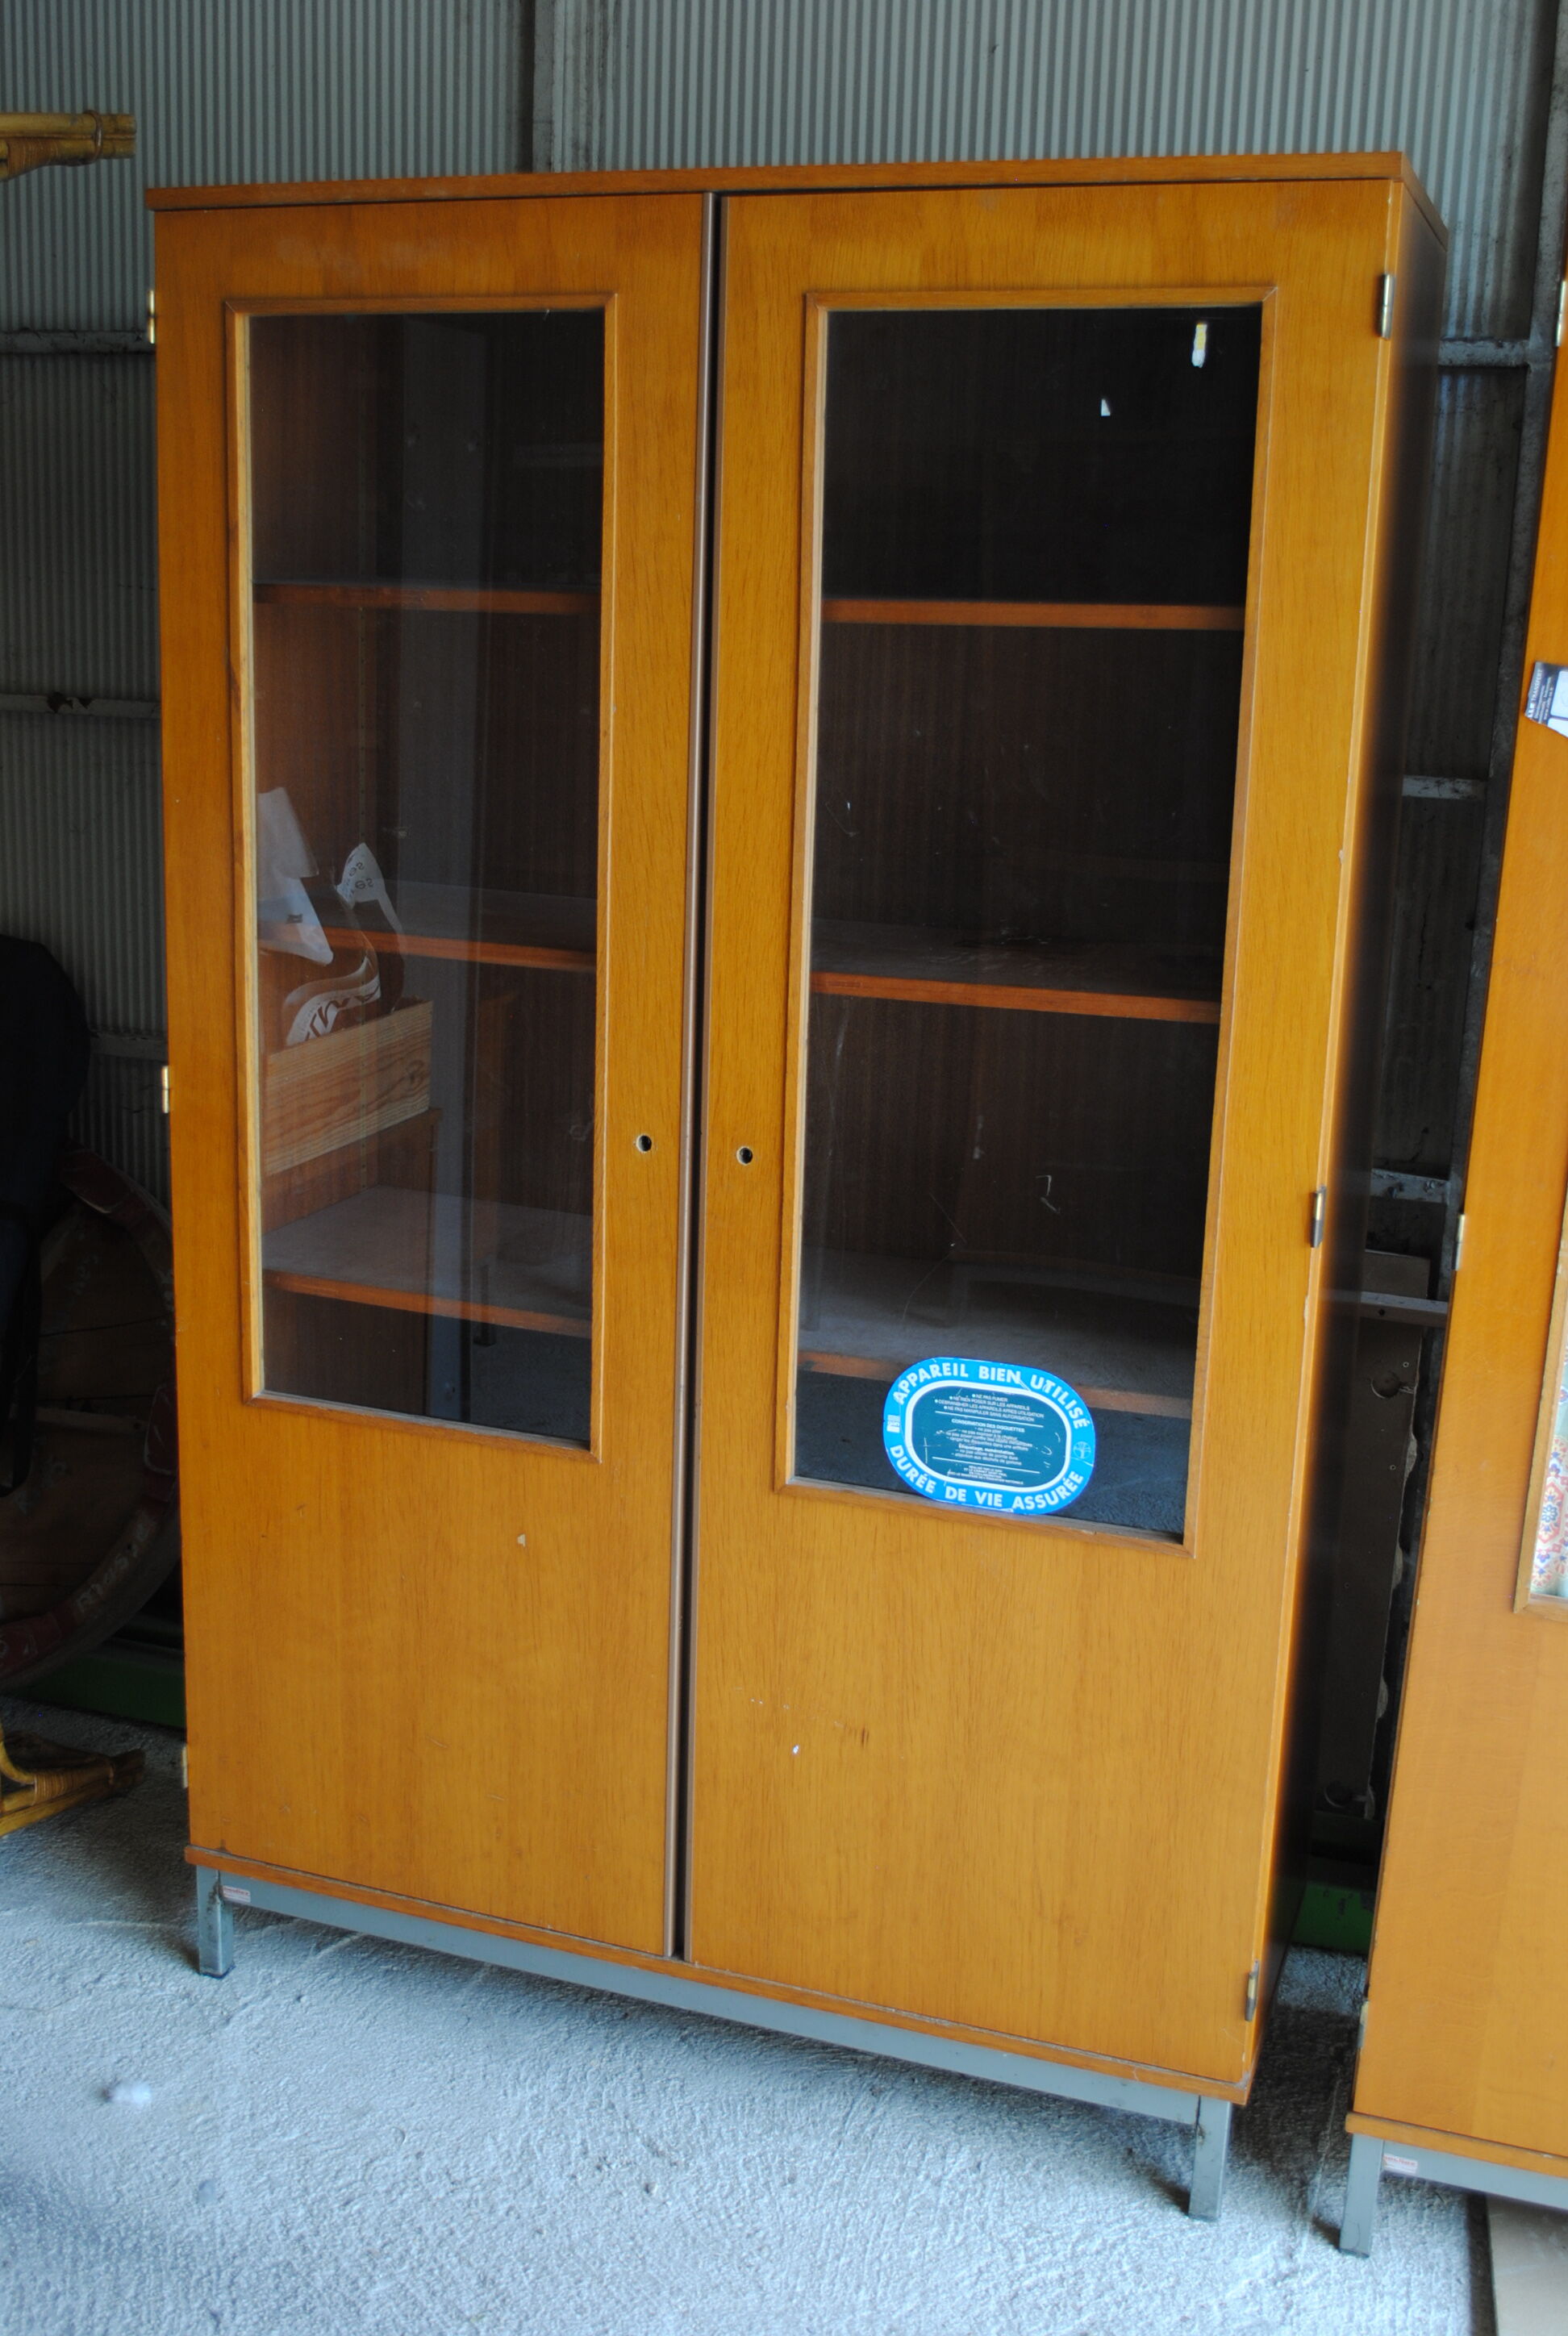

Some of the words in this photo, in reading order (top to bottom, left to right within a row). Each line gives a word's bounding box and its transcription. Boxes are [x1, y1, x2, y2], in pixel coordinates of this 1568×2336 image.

[893, 1362, 969, 1405] APPAREIL
[979, 1365, 1021, 1383] BIEN
[1030, 1374, 1090, 1428] UTILISÉ
[890, 1445, 936, 1493] DURÉE
[945, 1486, 967, 1502] DE
[975, 1490, 1003, 1507] VIE
[1012, 1471, 1084, 1510] ASSURÉE
